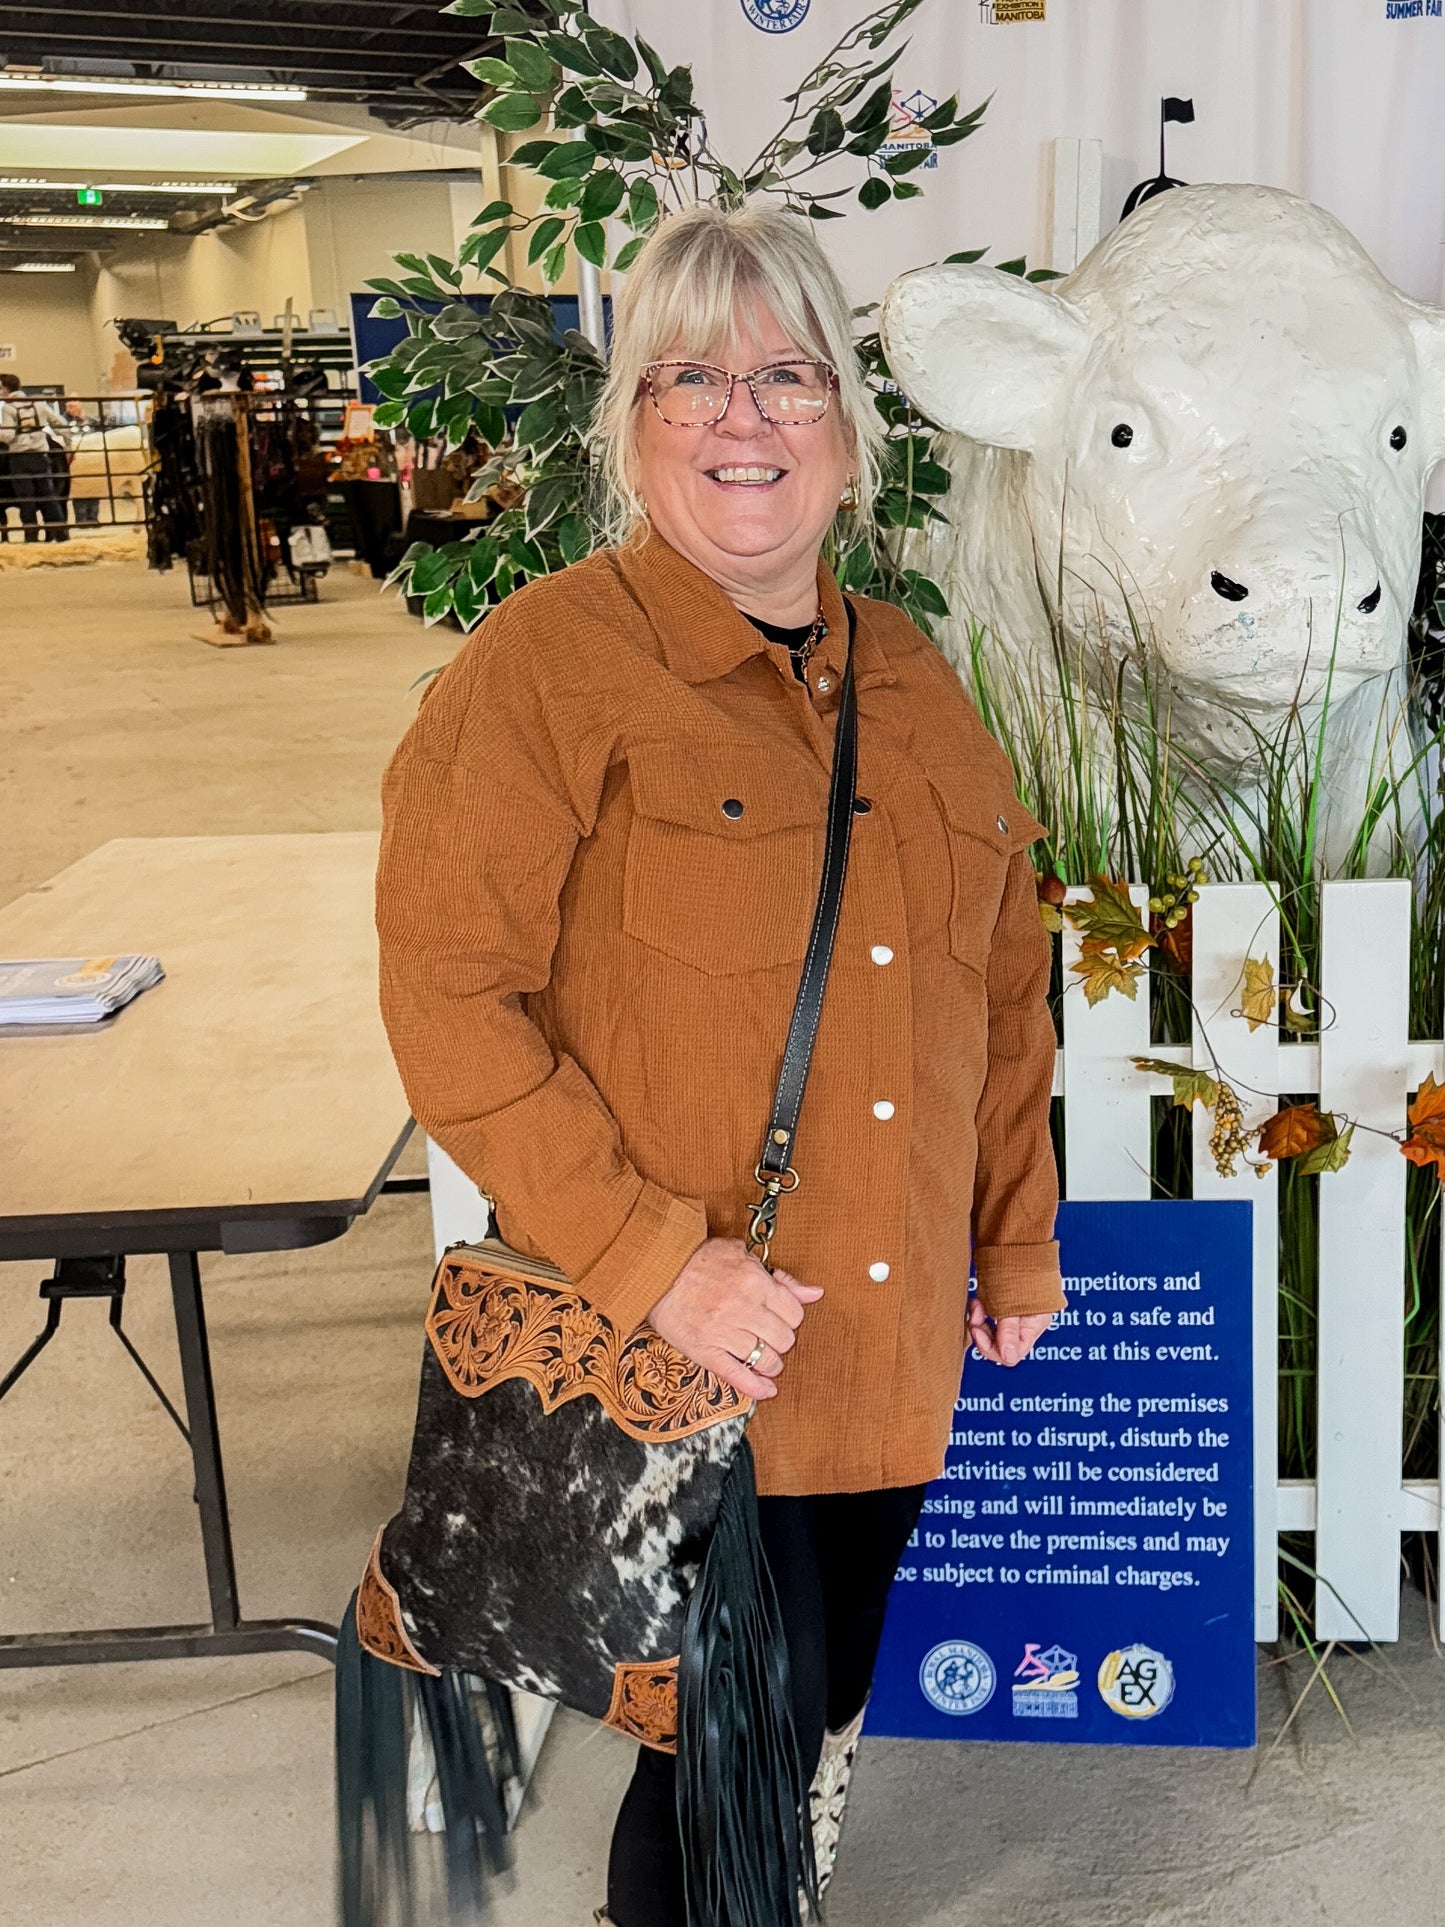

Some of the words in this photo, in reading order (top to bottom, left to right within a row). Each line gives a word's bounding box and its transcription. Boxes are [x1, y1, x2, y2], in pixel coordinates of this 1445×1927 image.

[749, 4, 788, 30] WINTER
[995, 11, 1045, 21] MANITOBA
[1385, 1, 1423, 19] SUMMER
[1061, 1272, 1157, 1296] mpetitors
[1164, 1272, 1200, 1290] and
[1048, 1309, 1079, 1330] ght
[1086, 1310, 1106, 1325] to
[1112, 1312, 1124, 1325] a
[1130, 1307, 1171, 1325] safe
[1178, 1306, 1214, 1325] and
[1089, 1345, 1107, 1360] at
[1113, 1341, 1150, 1360] this
[1156, 1344, 1218, 1360] event.
[954, 1393, 1003, 1411] ound
[1010, 1393, 1093, 1417] entering
[1100, 1393, 1131, 1412] the
[1138, 1393, 1228, 1417] premises
[948, 1428, 1005, 1445] intent
[1012, 1430, 1031, 1446] to
[1037, 1427, 1115, 1451] disrupt,
[1120, 1428, 1191, 1447] disturb
[1198, 1428, 1229, 1447] the
[1033, 1462, 1071, 1480] will
[1078, 1462, 1102, 1481] be
[1108, 1462, 1218, 1481] considered
[982, 1496, 1018, 1514] and
[1025, 1496, 1063, 1514] will
[1071, 1496, 1196, 1521] immediately
[1203, 1497, 1227, 1516] be
[925, 1532, 945, 1547] to
[952, 1529, 1004, 1548] leave
[1010, 1530, 1040, 1549] the
[1047, 1531, 1137, 1554] premises
[1143, 1532, 1179, 1550] and
[1187, 1537, 1230, 1556] may
[923, 1563, 994, 1587] subject
[1000, 1567, 1020, 1583] to
[1026, 1565, 1109, 1584] criminal
[1115, 1566, 1199, 1590] charges.
[1116, 1658, 1157, 1681] AG
[1121, 1681, 1156, 1706] EX
